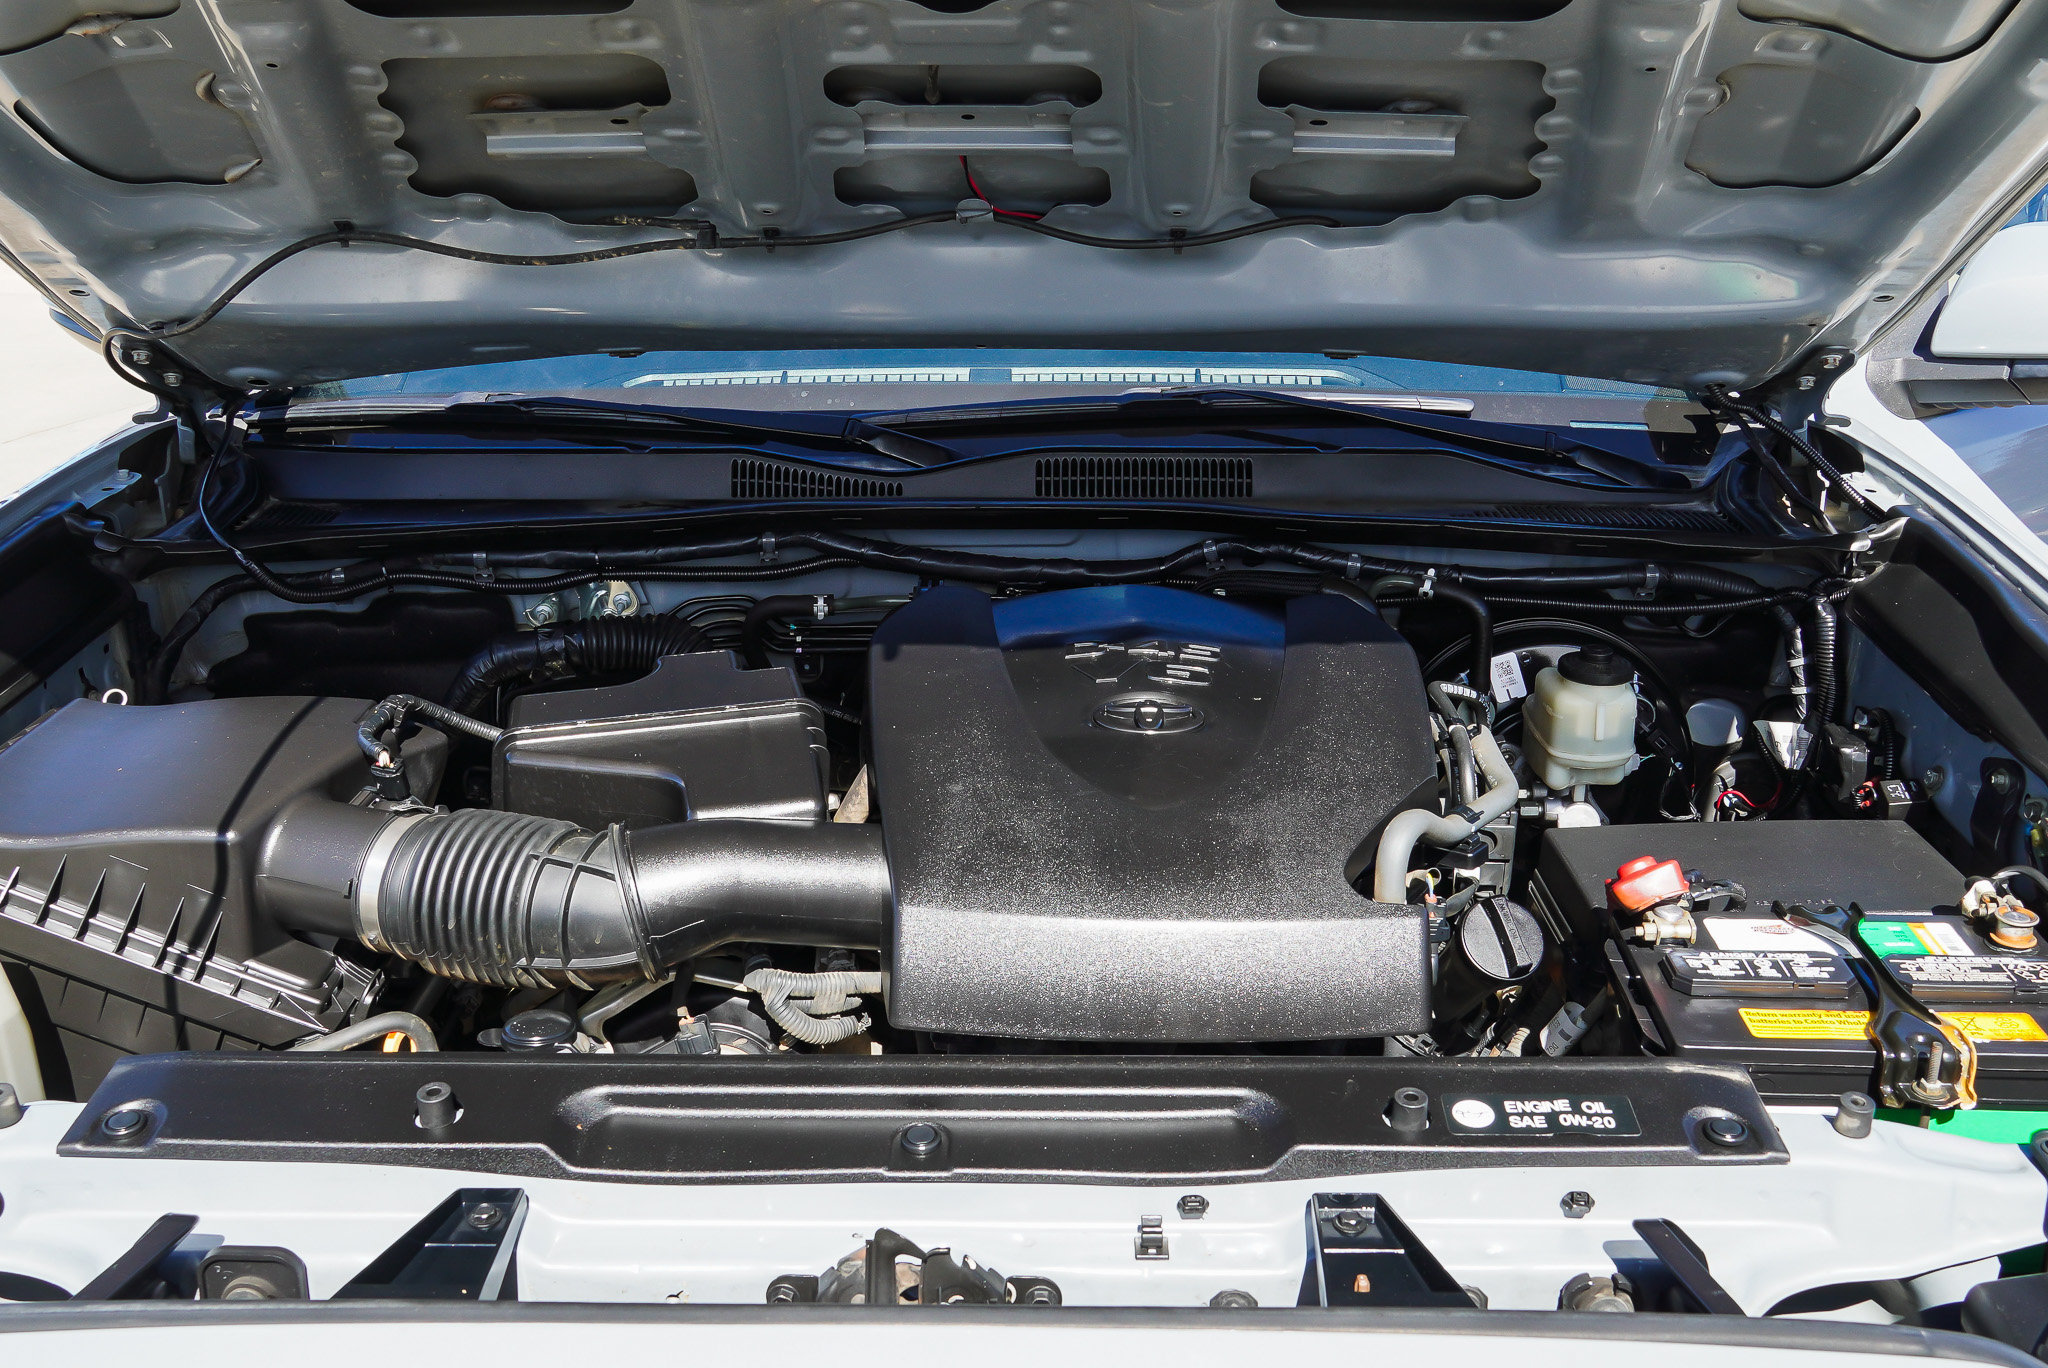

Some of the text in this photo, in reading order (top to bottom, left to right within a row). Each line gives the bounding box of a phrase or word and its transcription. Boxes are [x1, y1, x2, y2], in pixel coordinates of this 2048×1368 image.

[1744, 1010, 1777, 1018] Return
[1749, 1017, 1791, 1025] batteries
[1503, 1099, 1613, 1114] ENGINE OIL
[1508, 1113, 1617, 1129] SAE 0W-20
